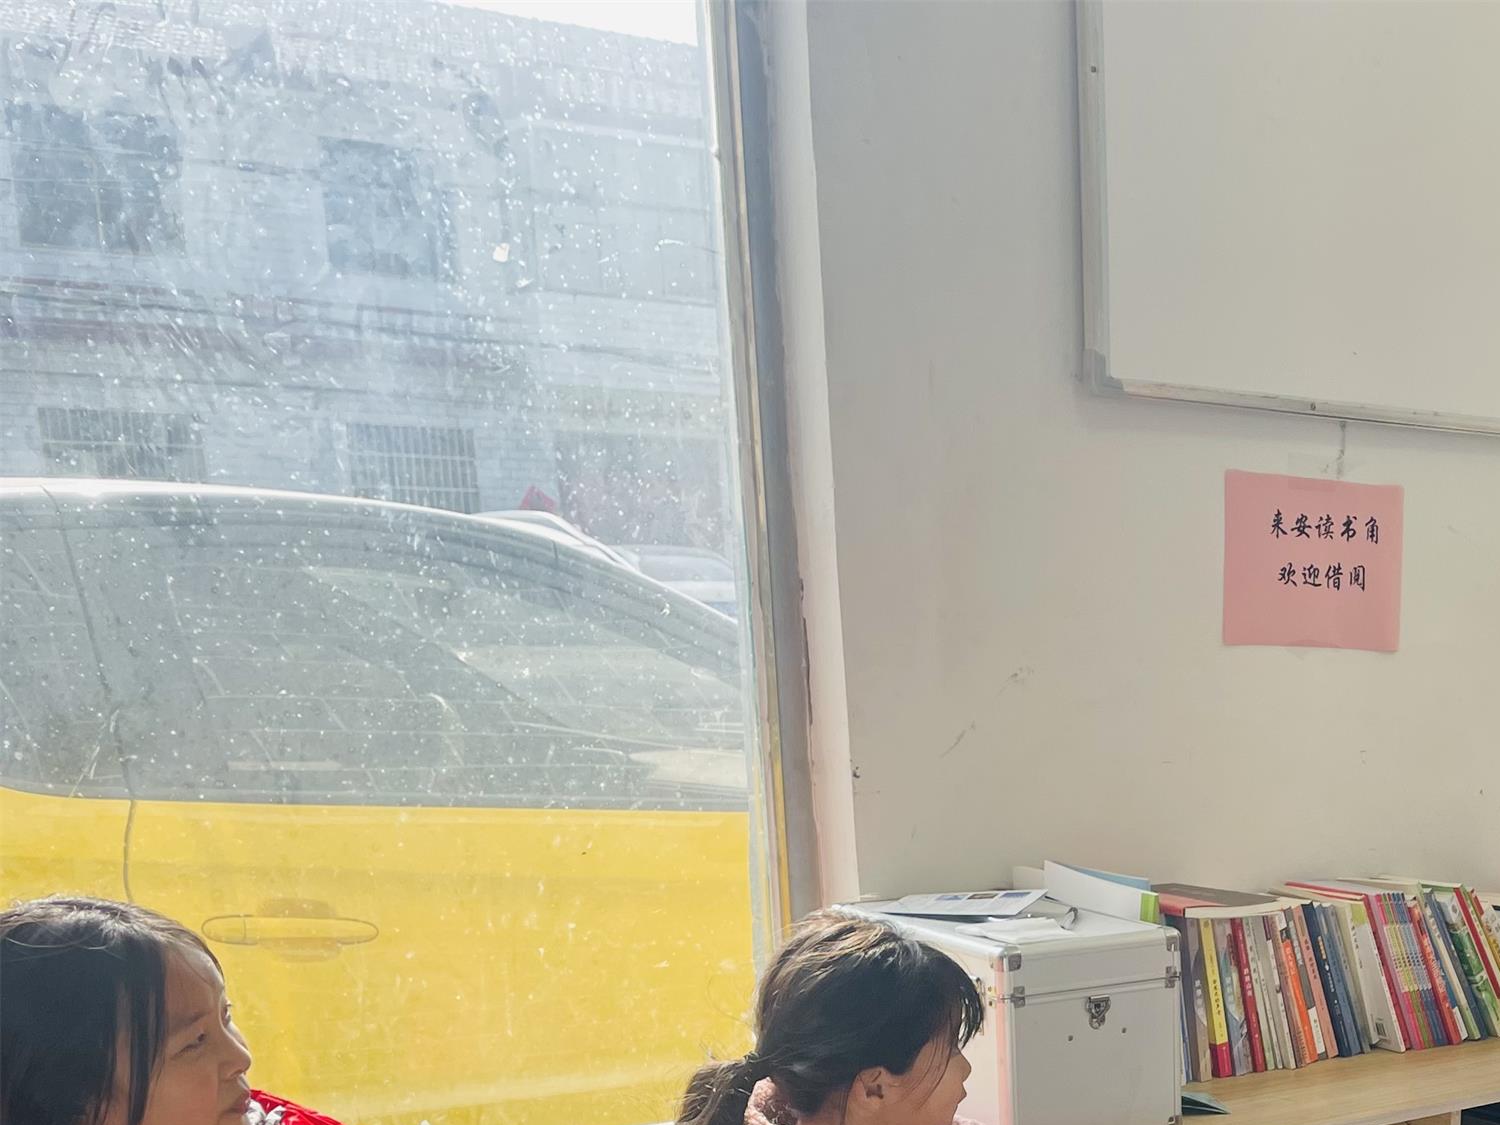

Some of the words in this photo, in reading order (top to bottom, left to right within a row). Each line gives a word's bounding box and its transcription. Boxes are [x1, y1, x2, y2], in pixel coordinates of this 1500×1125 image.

[1269, 508, 1380, 545] 来安读书角
[1277, 562, 1366, 592] 欢迎借阅
